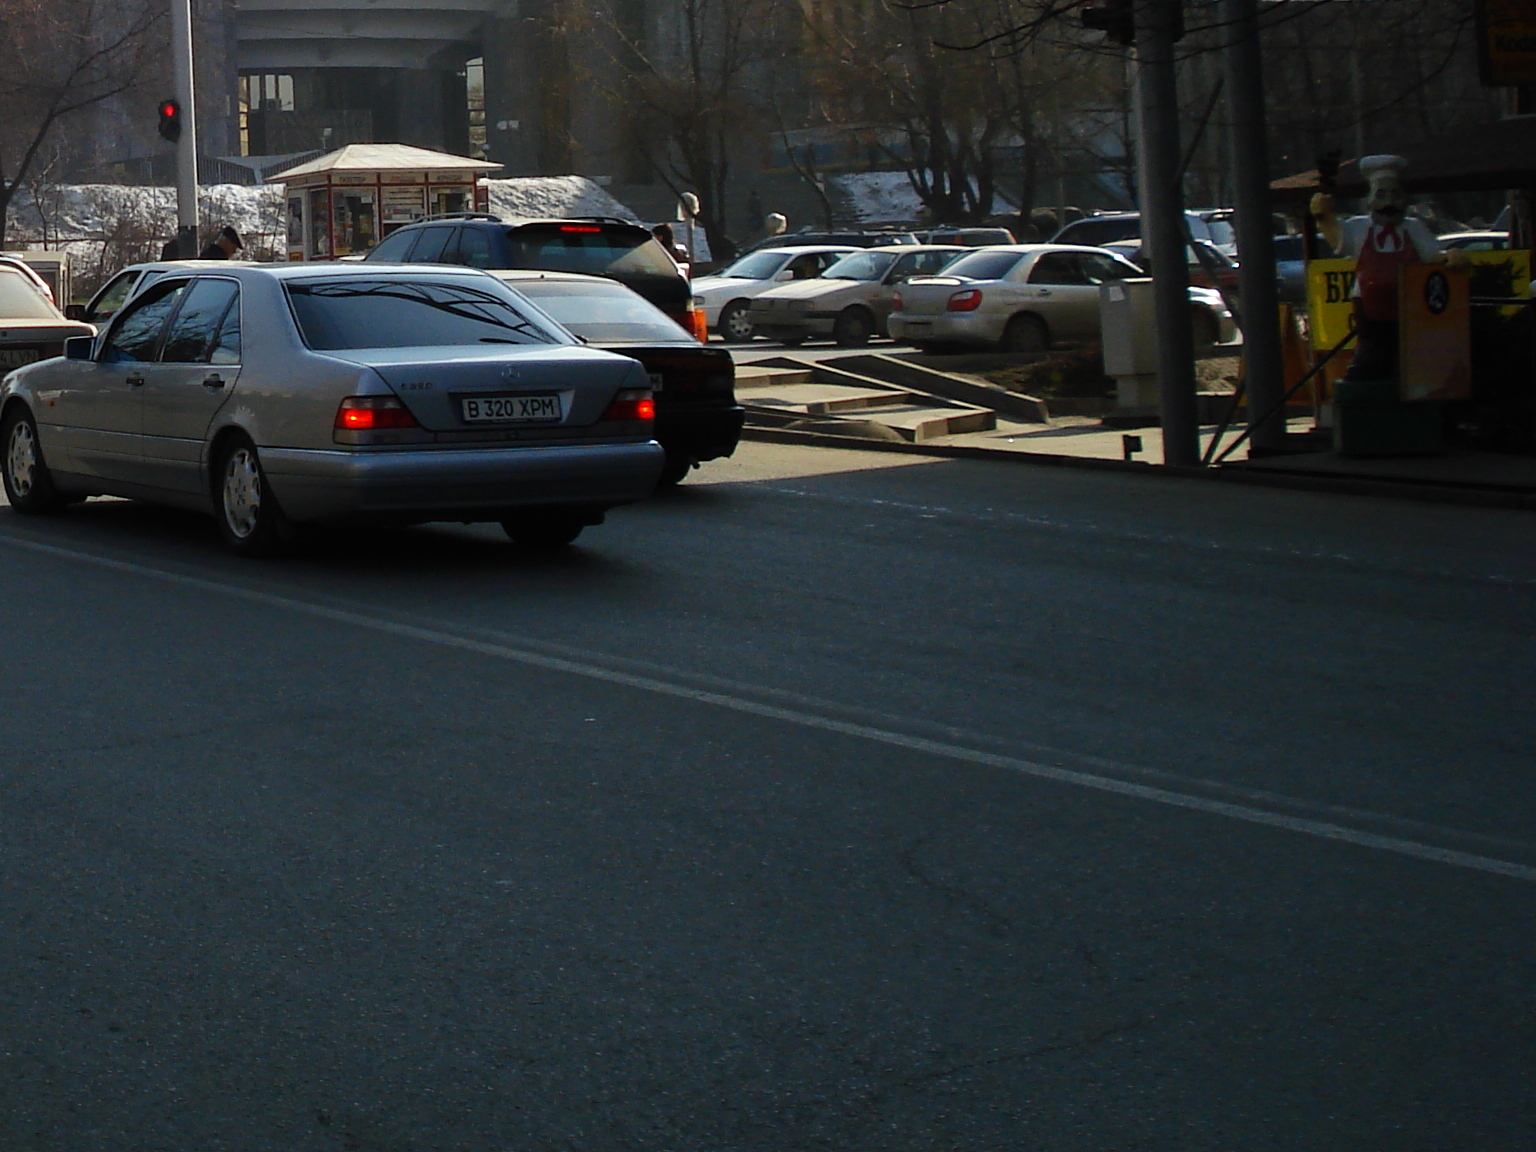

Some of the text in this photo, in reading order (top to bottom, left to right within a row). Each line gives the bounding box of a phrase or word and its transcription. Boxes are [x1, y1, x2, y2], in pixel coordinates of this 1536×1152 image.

[468, 399, 555, 418] B 320 XPM
